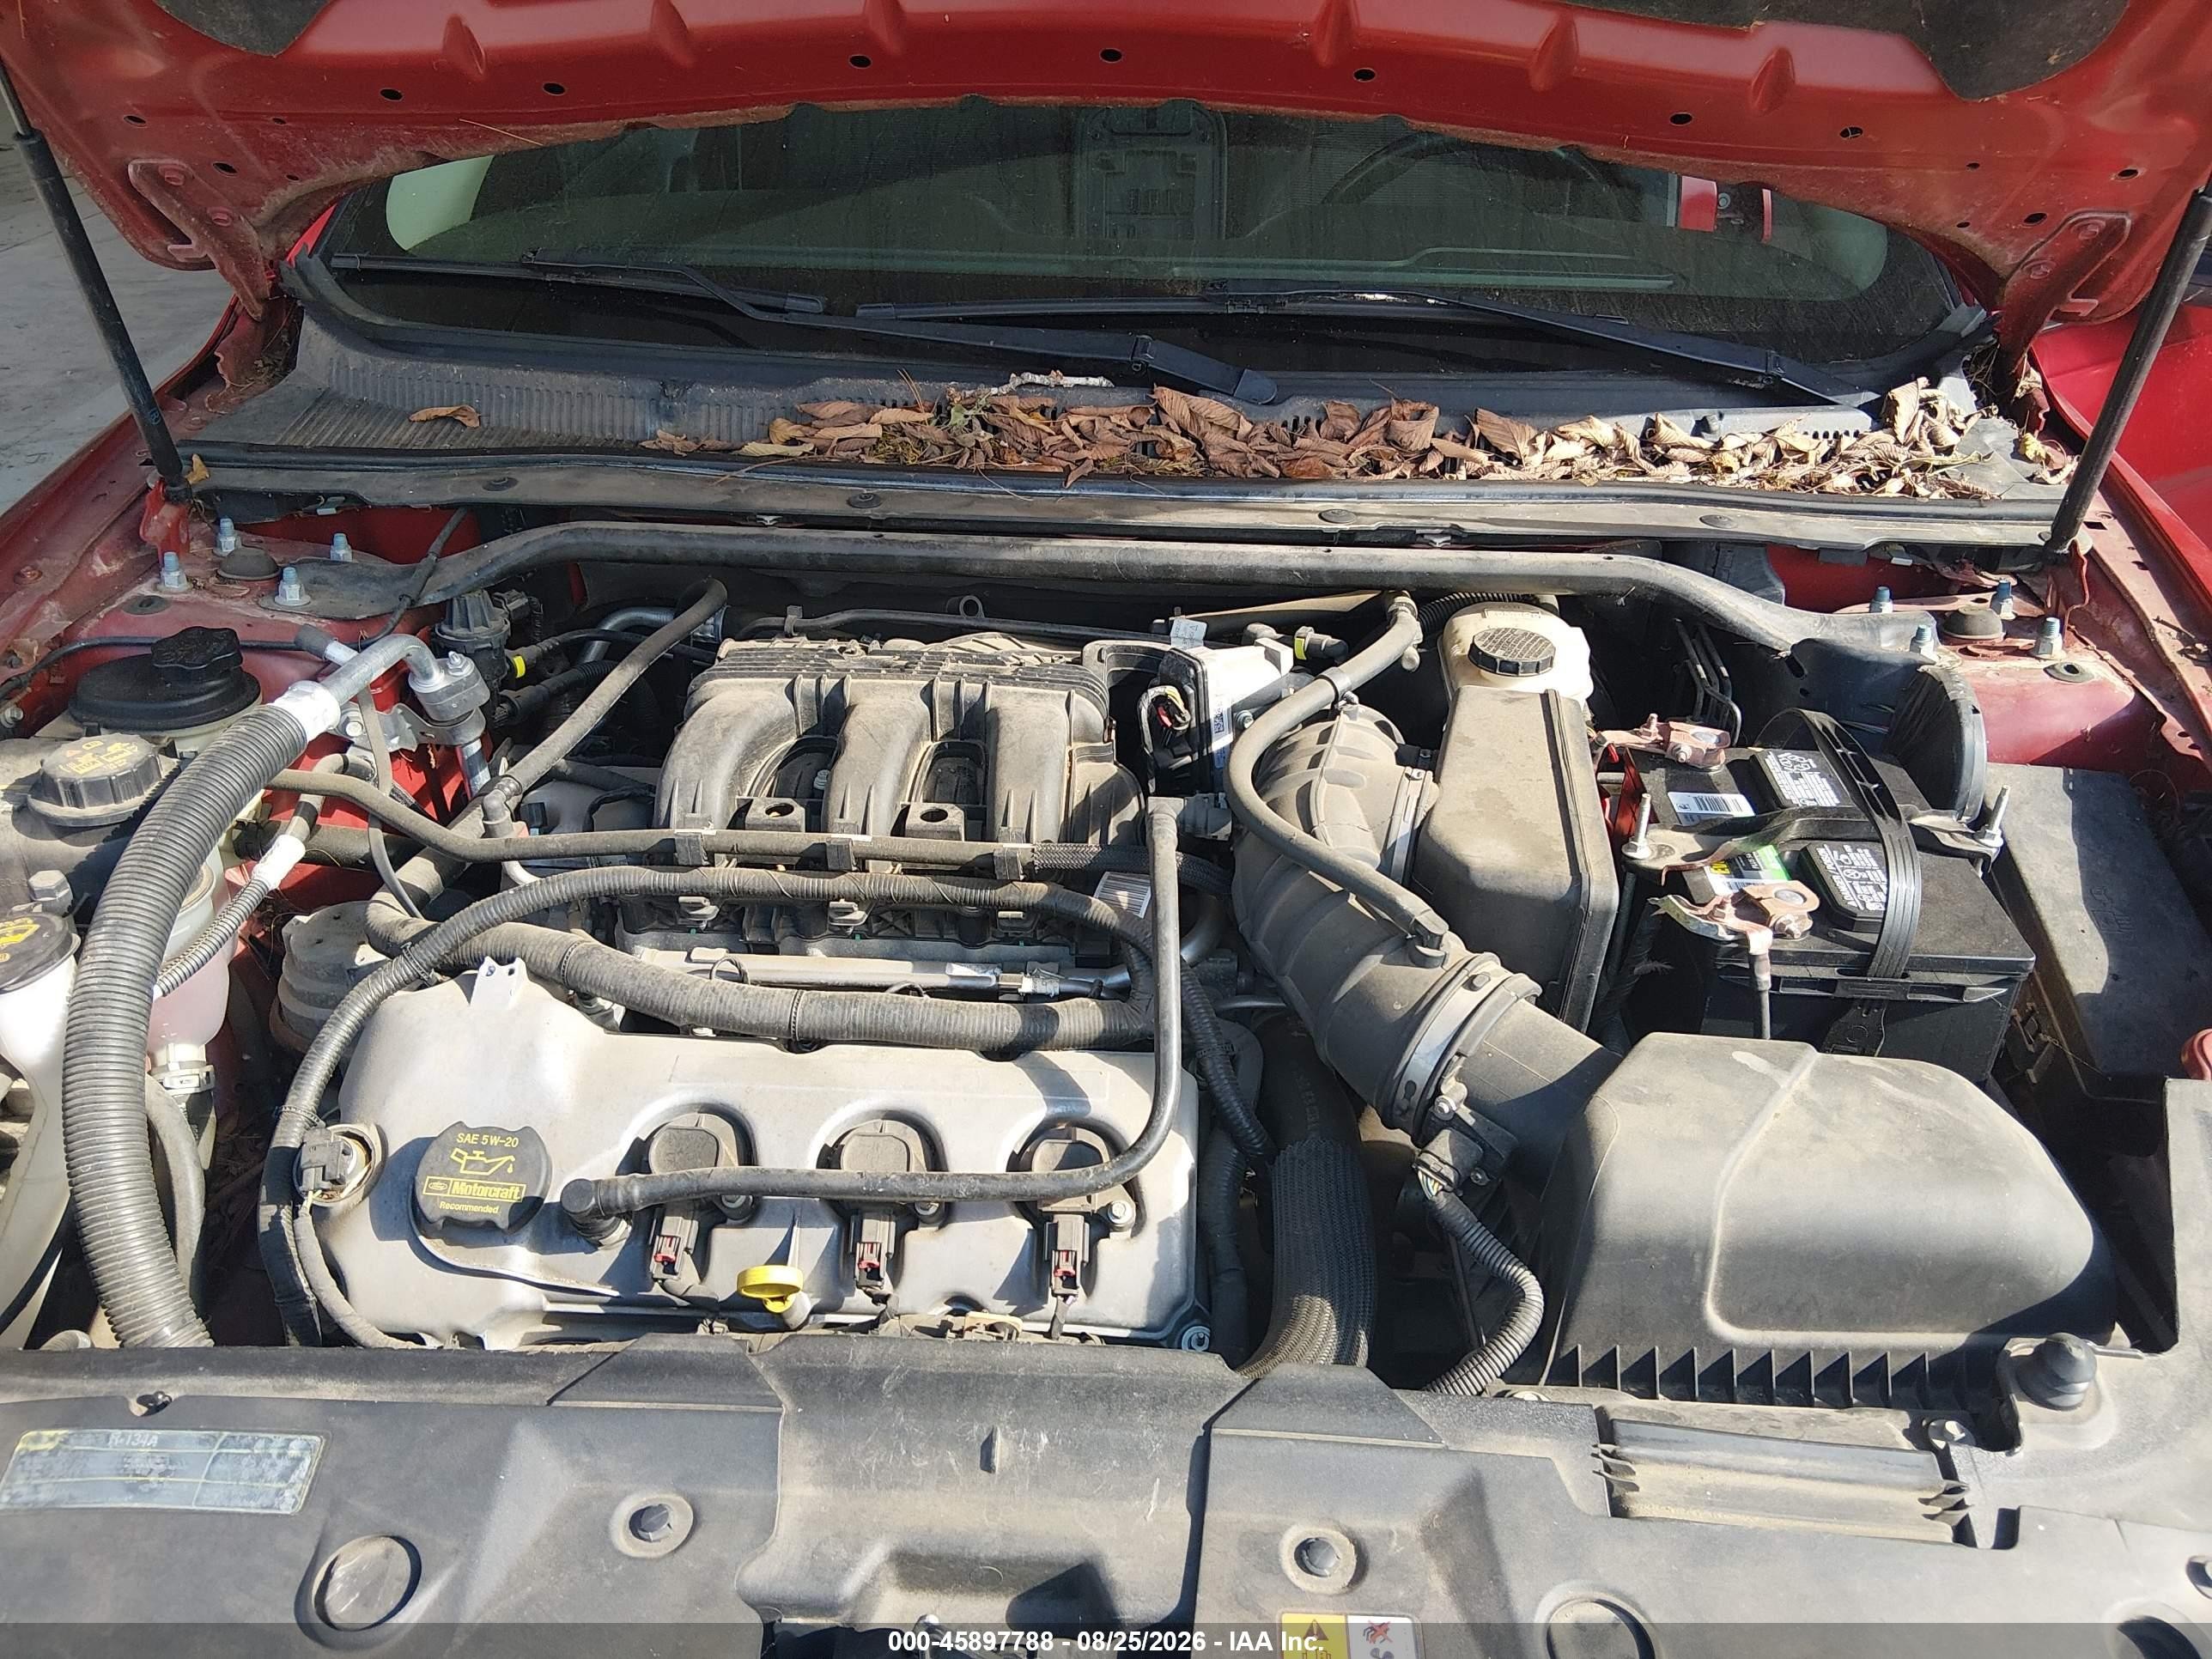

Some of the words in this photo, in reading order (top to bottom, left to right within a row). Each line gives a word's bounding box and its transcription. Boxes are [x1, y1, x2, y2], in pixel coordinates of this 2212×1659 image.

[456, 1133, 479, 1144] SAE
[481, 1134, 519, 1147] 5W-20
[451, 1181, 520, 1200] Motorcraft
[439, 1200, 500, 1213] Recommended
